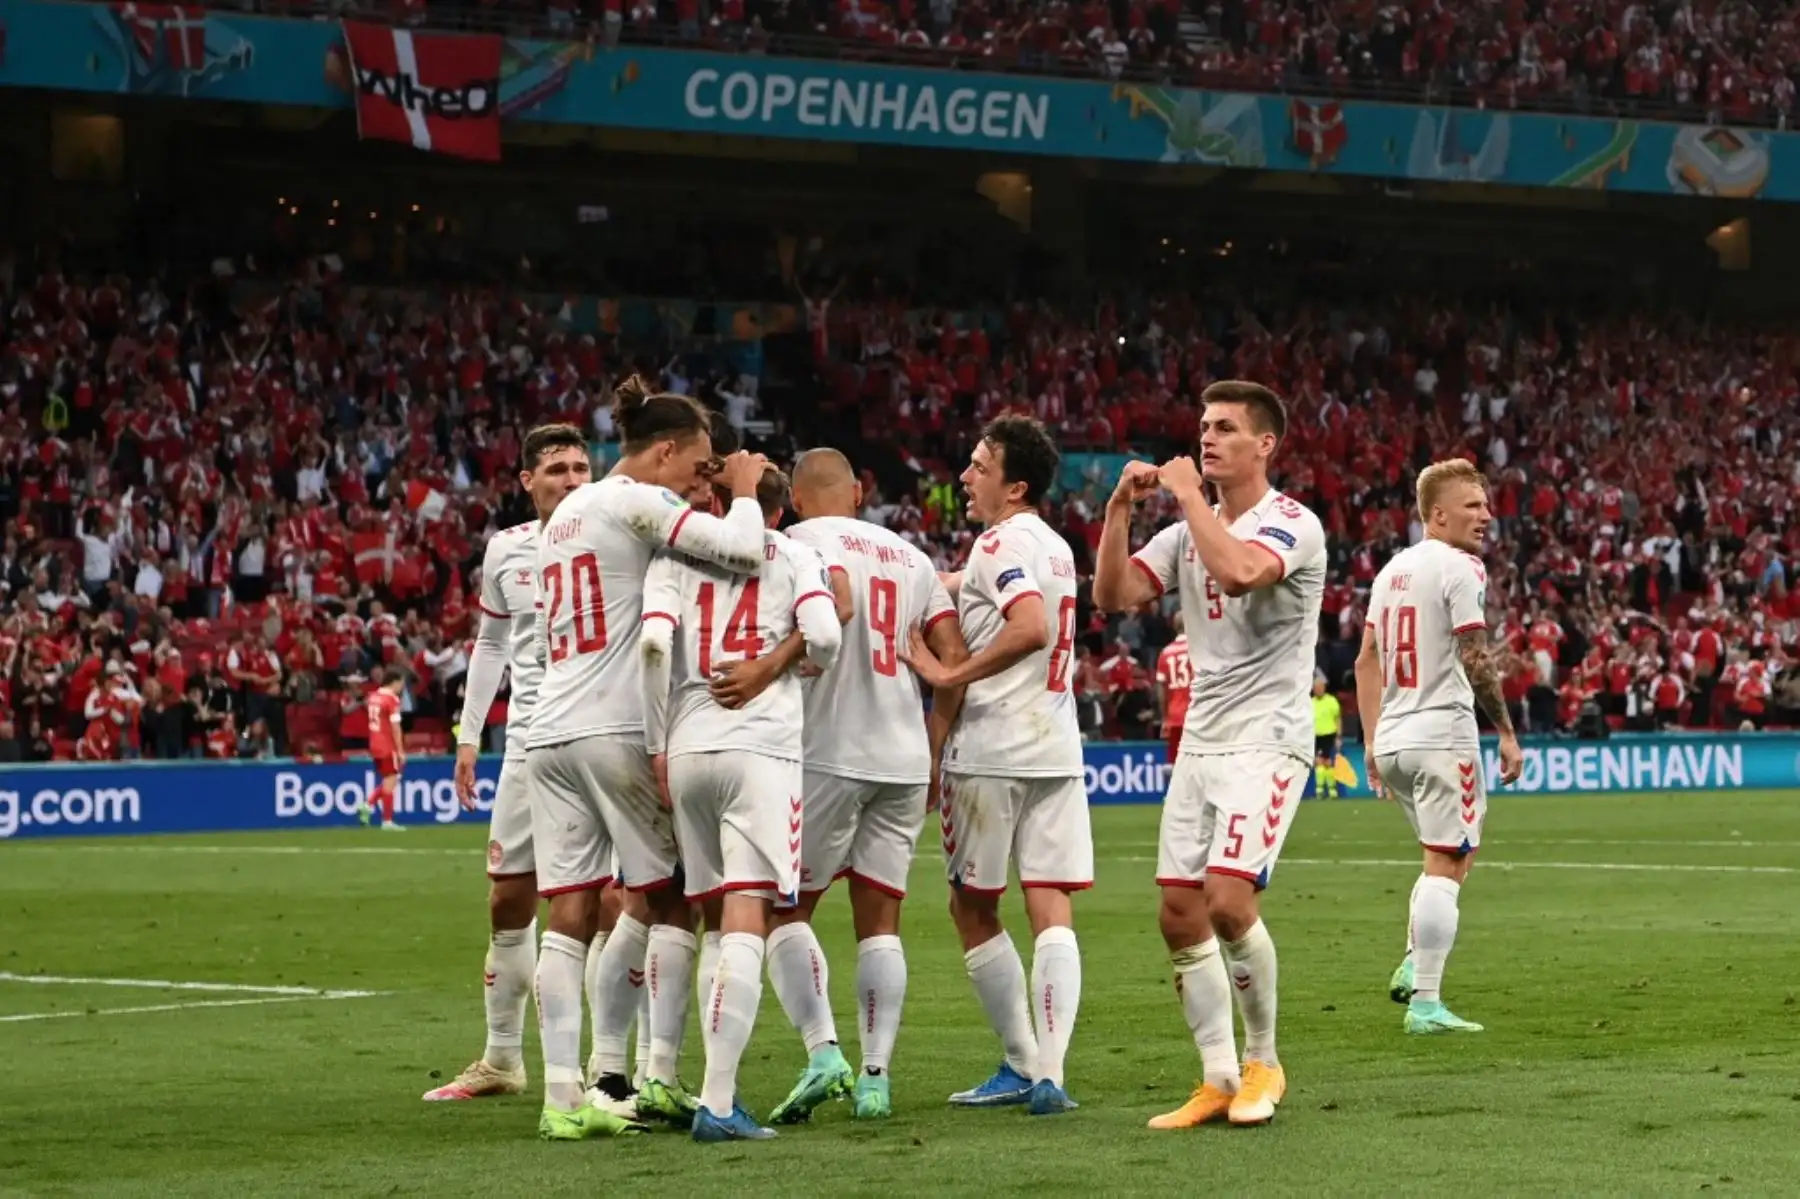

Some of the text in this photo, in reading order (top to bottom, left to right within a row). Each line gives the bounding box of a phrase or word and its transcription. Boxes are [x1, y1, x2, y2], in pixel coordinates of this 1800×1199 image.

[684, 68, 1050, 140] COPENHAGEN
[543, 552, 607, 664] 20
[696, 576, 764, 678] 14
[870, 576, 896, 677] 9
[1205, 575, 1223, 620] 5
[1047, 595, 1076, 692] 8
[1166, 653, 1190, 690] 13
[1381, 606, 1417, 688] 18
[1484, 745, 1744, 792] KØBENHAVN
[1223, 813, 1248, 860] 5
